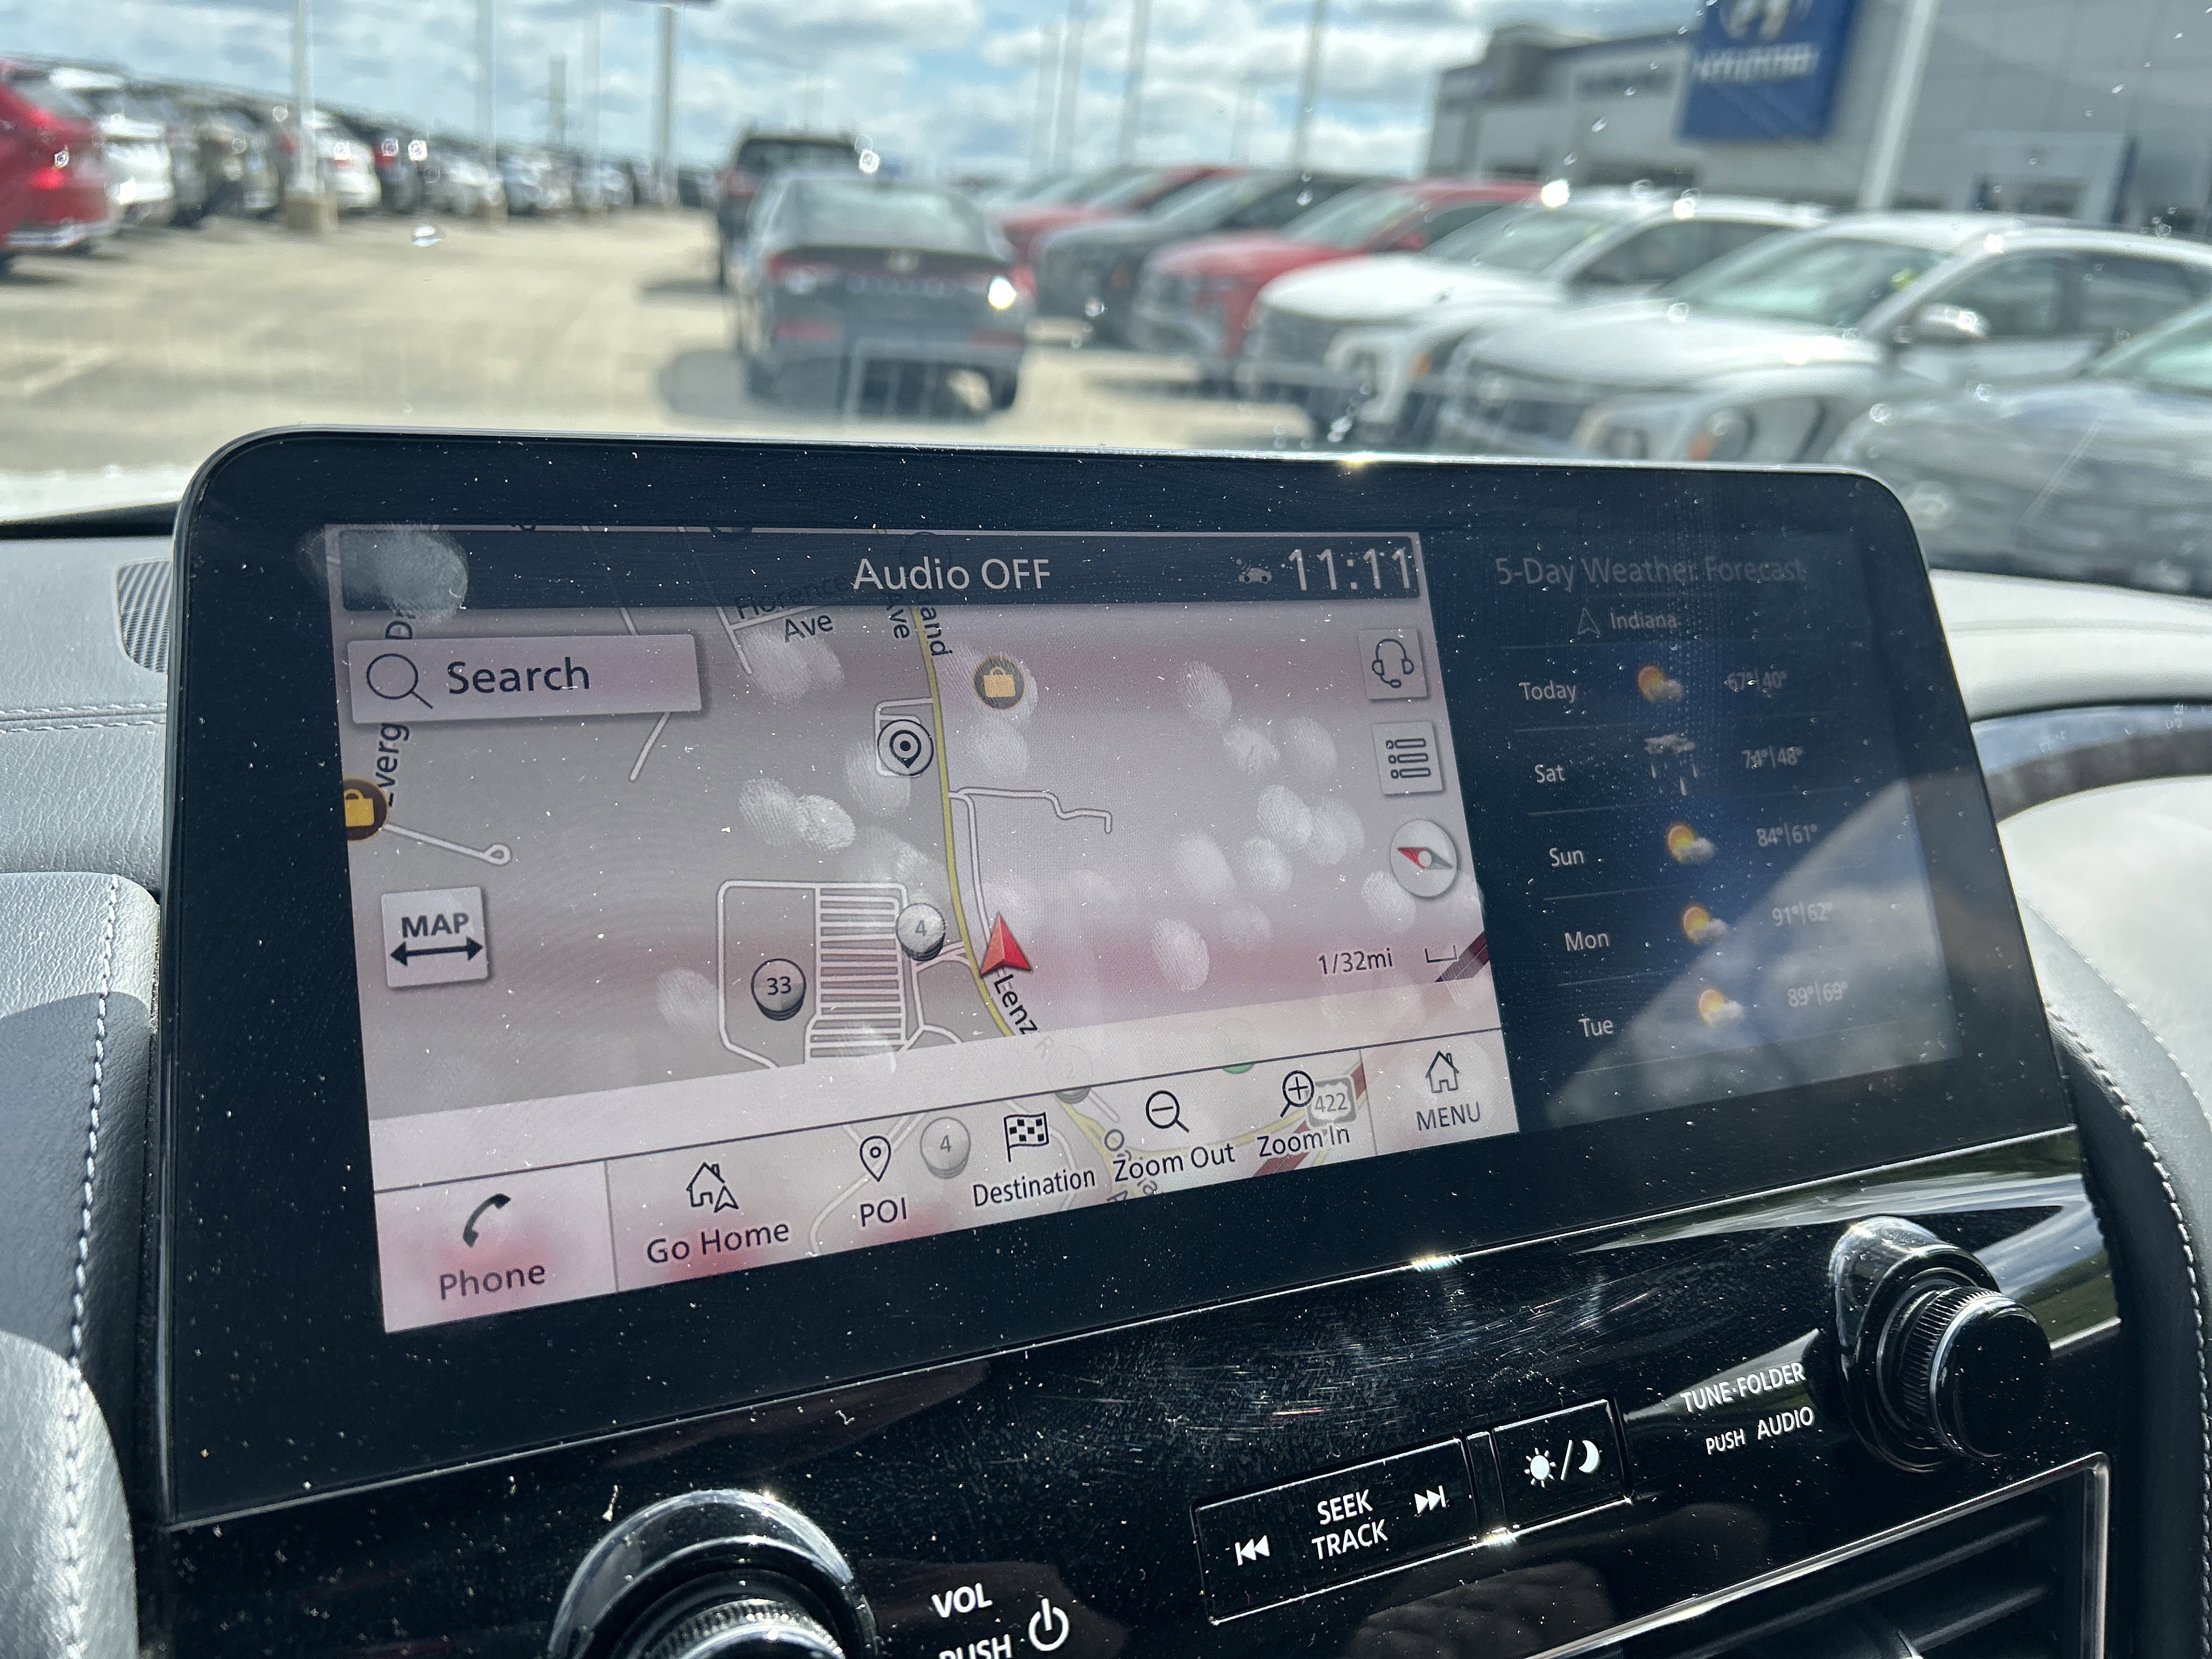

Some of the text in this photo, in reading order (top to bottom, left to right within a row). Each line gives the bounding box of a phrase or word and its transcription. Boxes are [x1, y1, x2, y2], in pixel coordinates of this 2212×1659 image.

[853, 556, 1050, 590] Audio OFF
[1288, 547, 1413, 591] 11:11
[1494, 555, 1805, 591] 5-Day Weather Forecast
[785, 614, 834, 643] Ave
[1609, 610, 1677, 631] Indiana
[448, 657, 590, 695] Search
[1519, 682, 1577, 703] Today
[1534, 764, 1566, 784] Sat
[1549, 848, 1585, 867] Sun
[400, 912, 470, 939] MAP
[915, 919, 928, 938] 4
[1564, 931, 1610, 952] Mon
[1317, 947, 1394, 975] 1/32mi
[766, 975, 792, 996] 33
[994, 974, 1039, 1035] Lenz
[1578, 1017, 1614, 1037] Tue
[1314, 1092, 1348, 1114] 422
[1416, 1101, 1481, 1132] MENU
[939, 1135, 952, 1154] 4
[1256, 1126, 1351, 1158] Zoom In
[1112, 1153, 1184, 1183] Zoom
[1190, 1142, 1235, 1169] Out
[972, 1166, 1097, 1207] Destination
[859, 1197, 909, 1227] POI
[646, 1221, 790, 1265] Go Home
[439, 1263, 546, 1301] Phone
[1705, 1406, 1815, 1455] PUSH AUDIO
[1317, 1488, 1374, 1526] SEEK
[1311, 1519, 1390, 1561] TRACK
[931, 1582, 994, 1619] VOL
